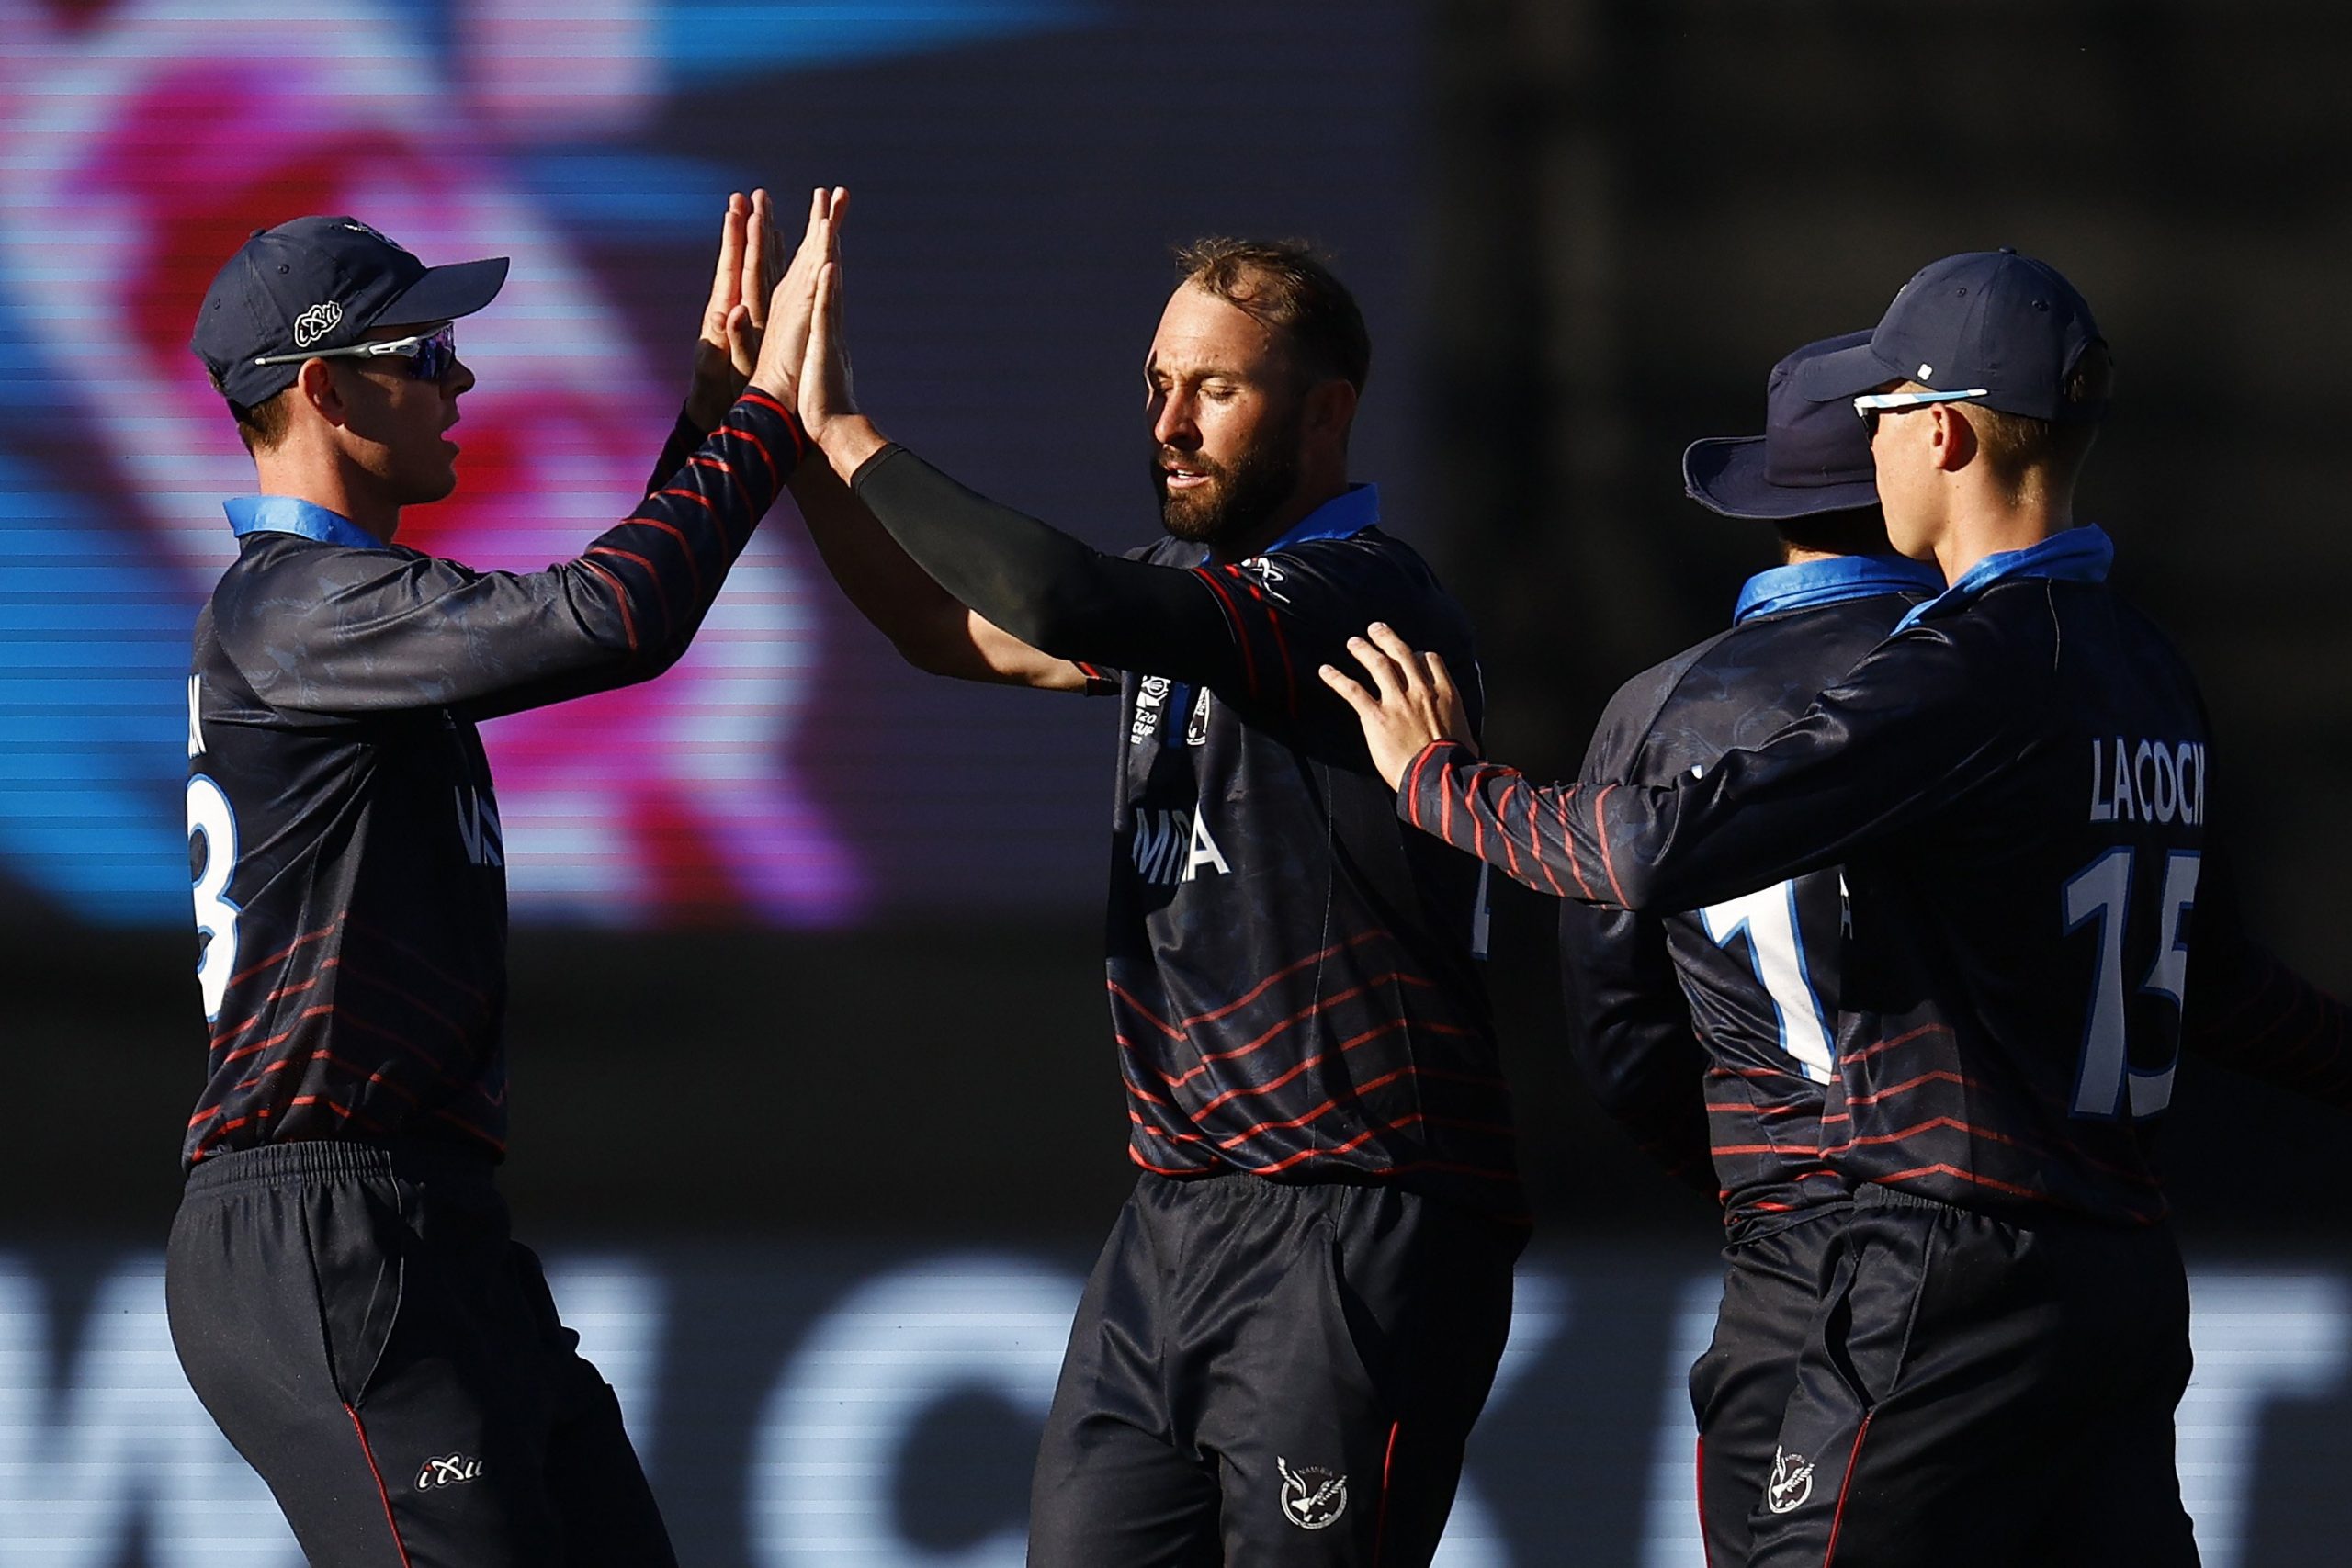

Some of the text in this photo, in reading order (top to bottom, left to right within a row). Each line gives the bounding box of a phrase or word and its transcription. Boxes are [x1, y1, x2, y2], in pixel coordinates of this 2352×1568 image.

[1135, 706, 1157, 724] T20
[1132, 721, 1155, 736] CUP
[2060, 844, 2201, 1121] 15
